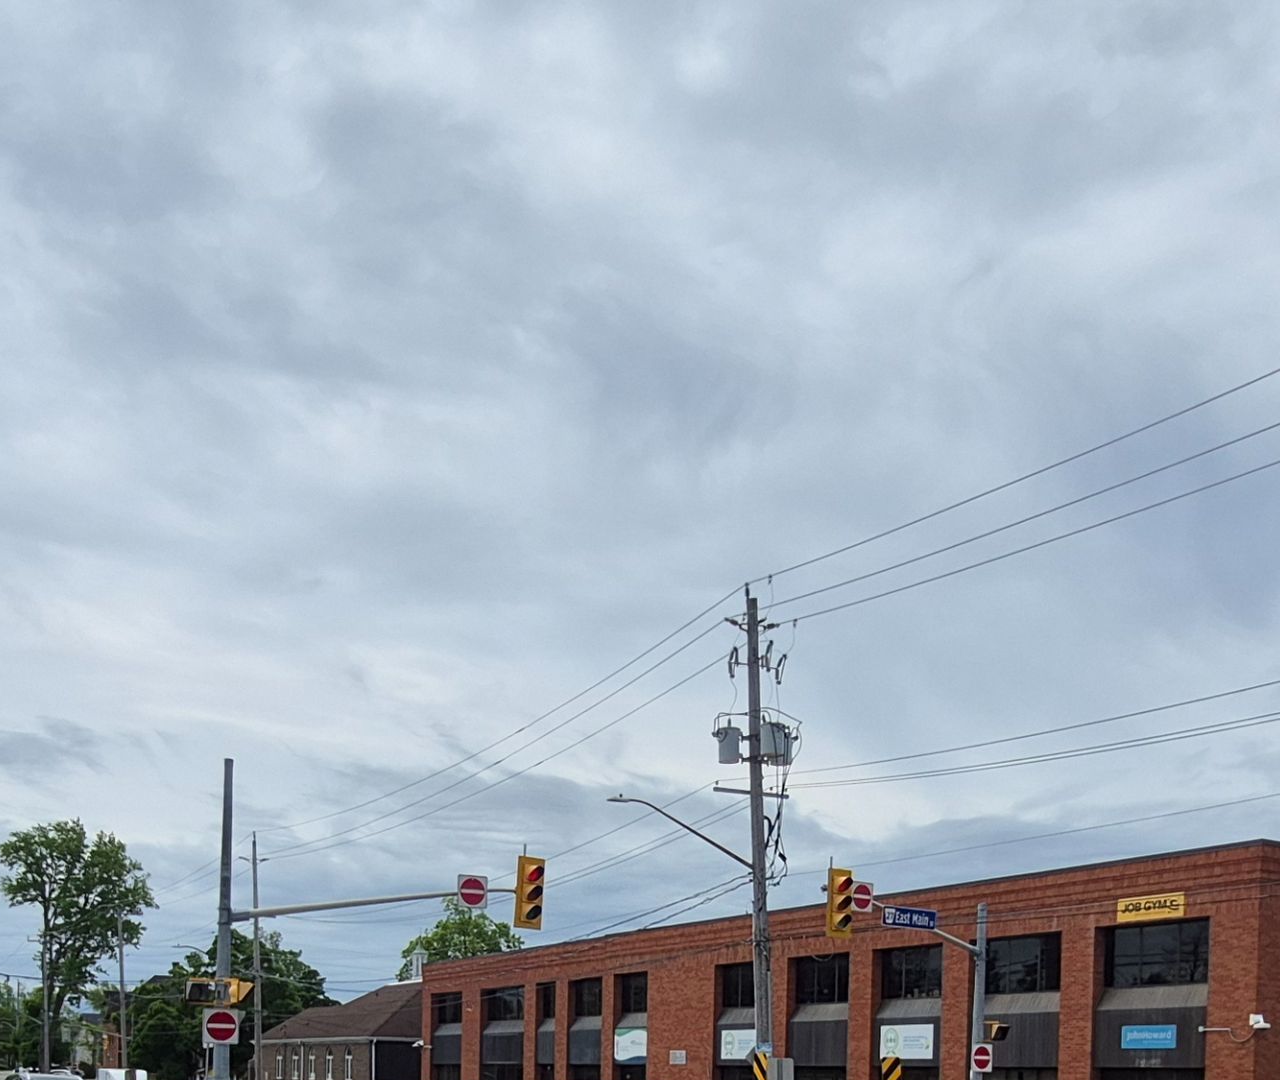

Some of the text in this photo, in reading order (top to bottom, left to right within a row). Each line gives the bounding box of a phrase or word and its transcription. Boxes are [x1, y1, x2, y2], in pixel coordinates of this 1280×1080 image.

[1121, 902, 1141, 913] JOB
[895, 911, 910, 924] East
[912, 913, 929, 926] Main
